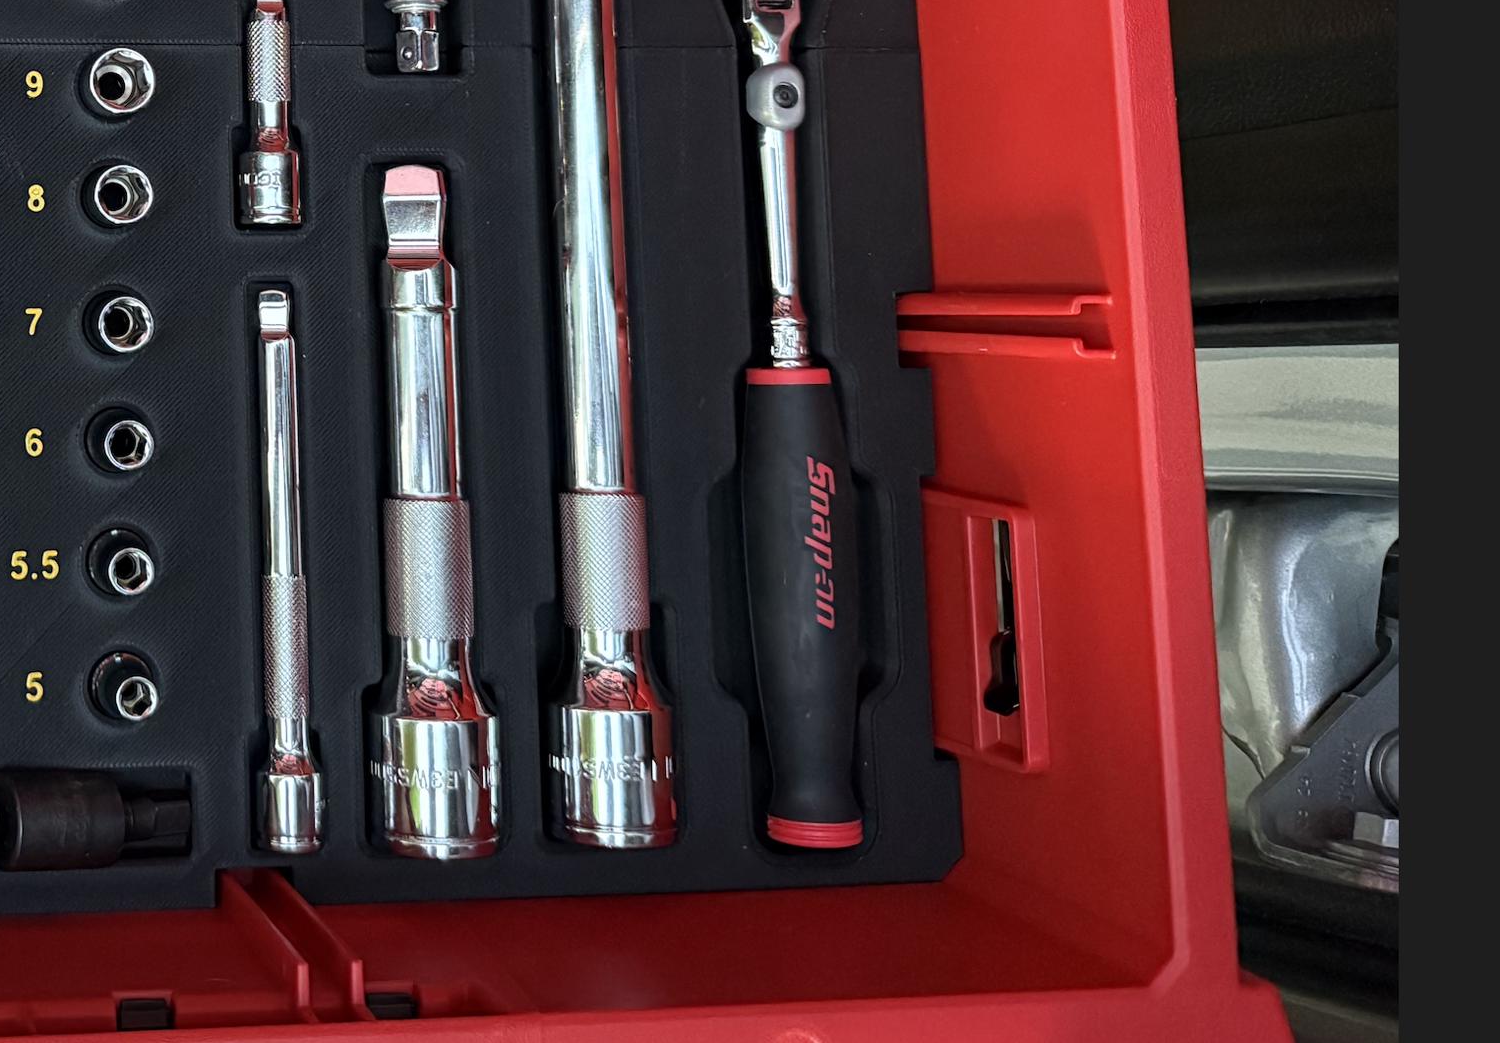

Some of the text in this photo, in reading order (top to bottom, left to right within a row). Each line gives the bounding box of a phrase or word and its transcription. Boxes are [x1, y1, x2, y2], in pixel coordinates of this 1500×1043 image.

[25, 71, 44, 99] 9
[27, 184, 46, 213] 8
[24, 307, 43, 335] 7
[24, 427, 43, 458] 6
[804, 456, 836, 630] Snap-on
[10, 549, 60, 581] 5.5
[25, 671, 44, 703] 5
